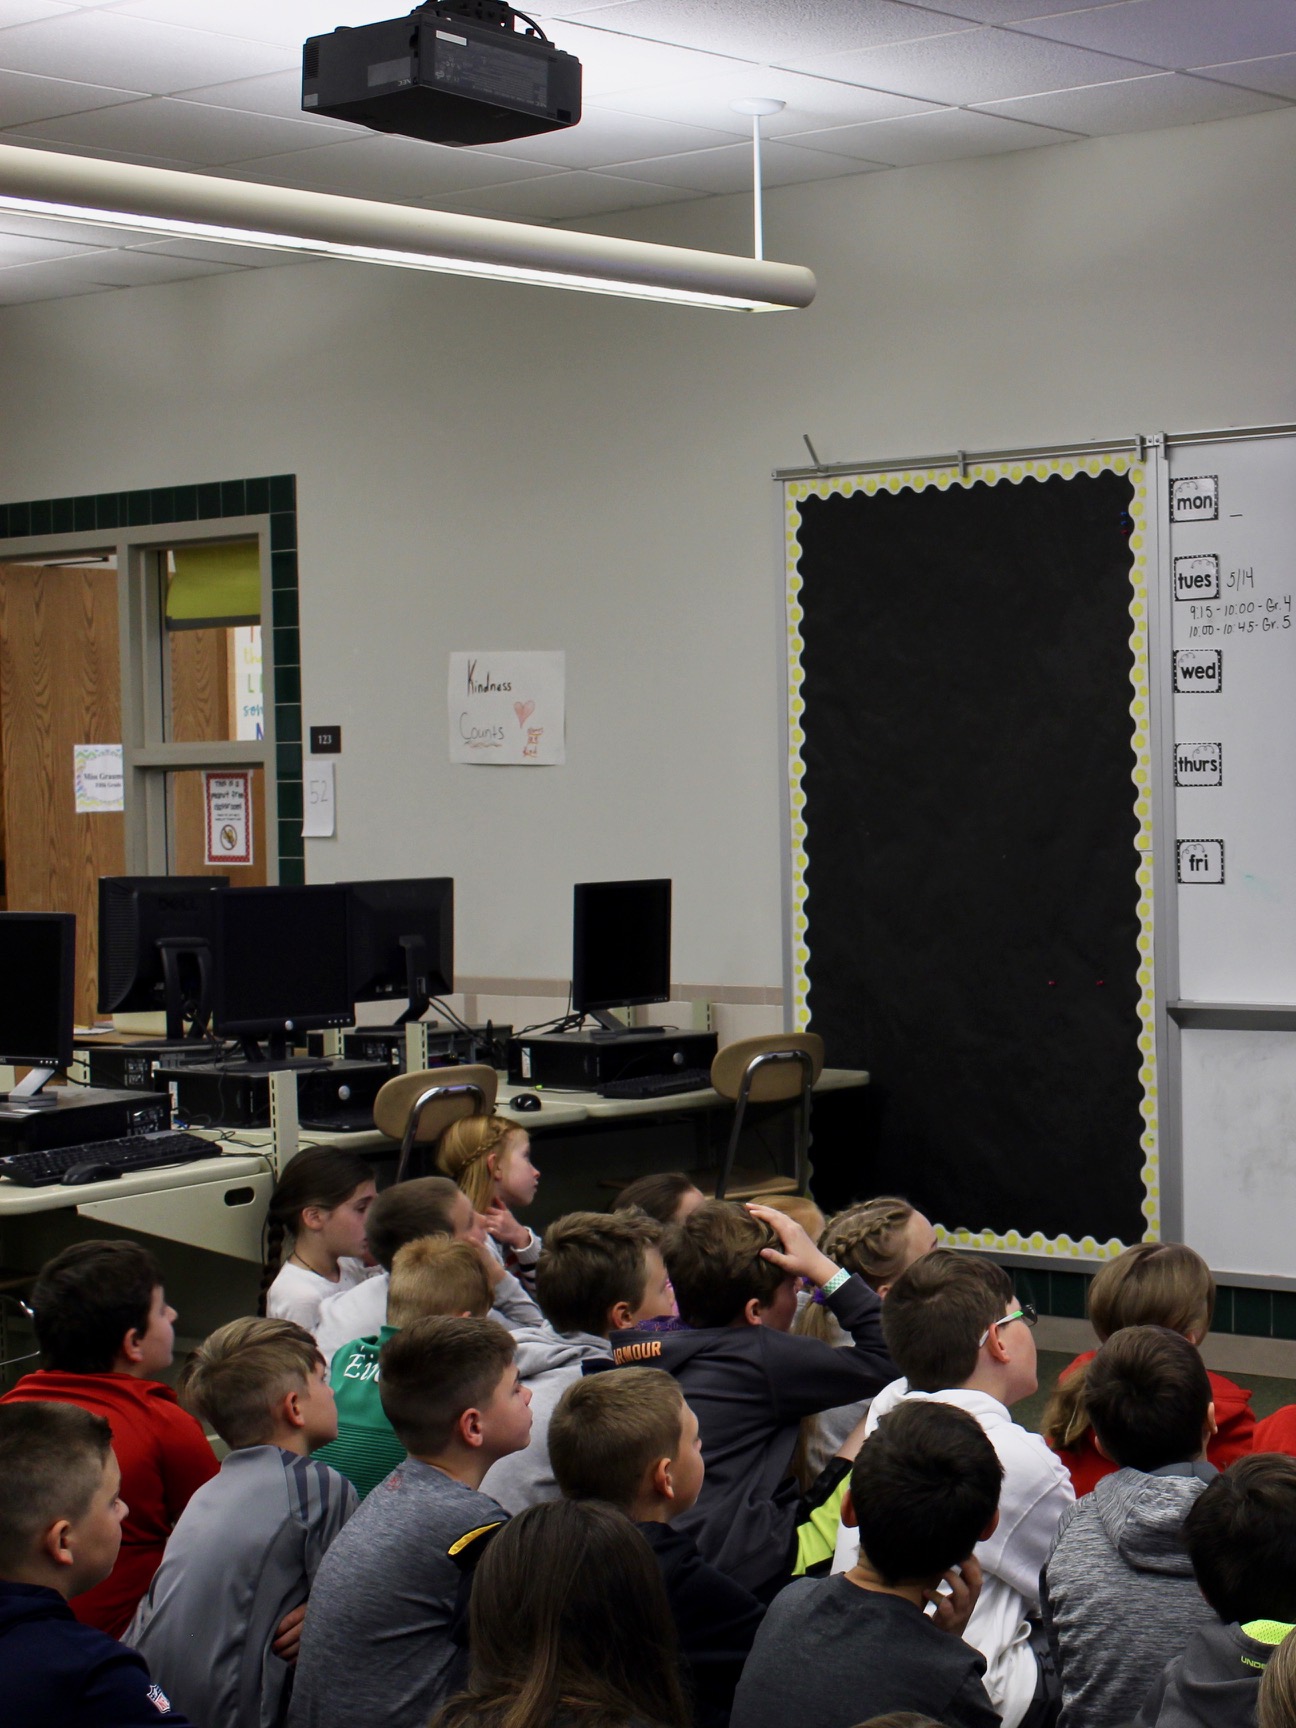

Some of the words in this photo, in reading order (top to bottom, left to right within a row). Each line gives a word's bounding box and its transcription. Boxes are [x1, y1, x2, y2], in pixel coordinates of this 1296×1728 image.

[1177, 495, 1213, 511] mon
[1178, 573, 1212, 590] tues
[1226, 567, 1254, 591] 5/14
[1284, 595, 1292, 612] 4
[1282, 615, 1292, 629] 5
[467, 659, 512, 697] Kindness
[1180, 662, 1216, 679] wed
[459, 711, 505, 741] Counts
[318, 734, 332, 745] 123
[1178, 756, 1218, 772] thurs
[310, 780, 328, 805] 52
[1189, 854, 1209, 871] fri
